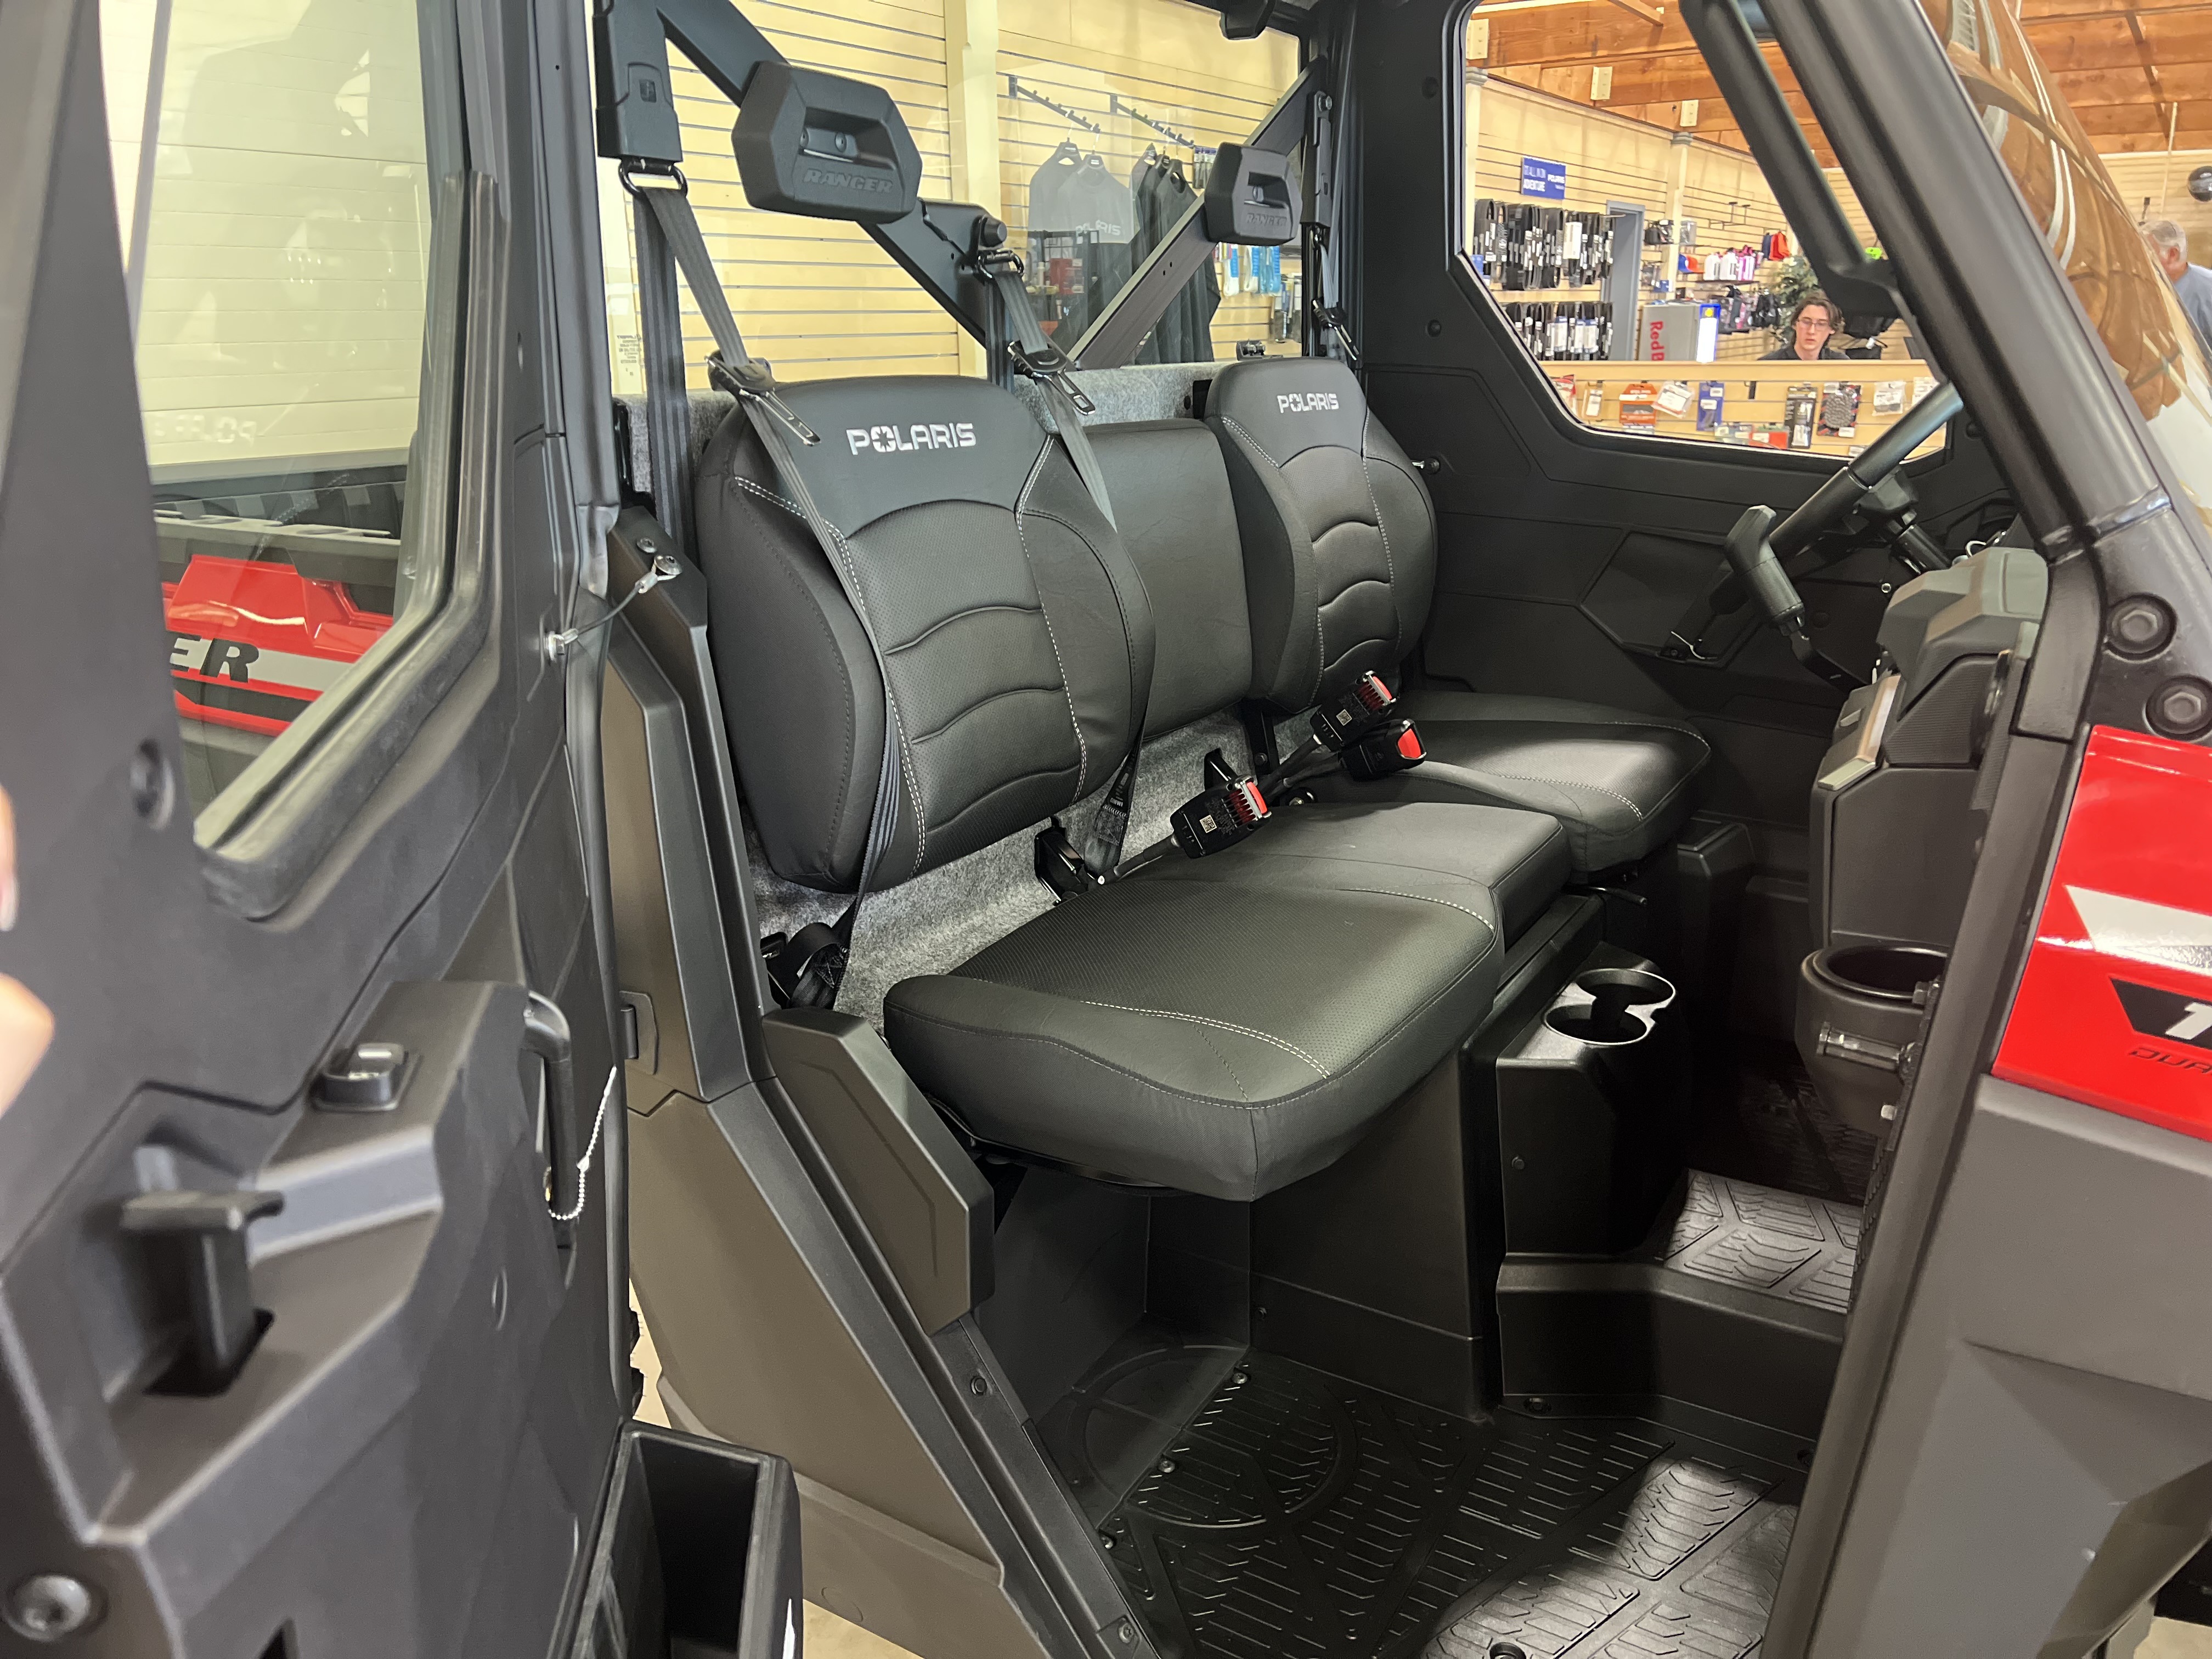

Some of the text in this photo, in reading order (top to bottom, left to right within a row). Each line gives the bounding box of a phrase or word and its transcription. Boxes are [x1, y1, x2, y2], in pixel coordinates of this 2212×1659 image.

[803, 168, 894, 193] RANGER
[1650, 321, 1665, 351] Red
[1277, 393, 1339, 413] POLARIS
[846, 422, 977, 455] POLARIS
